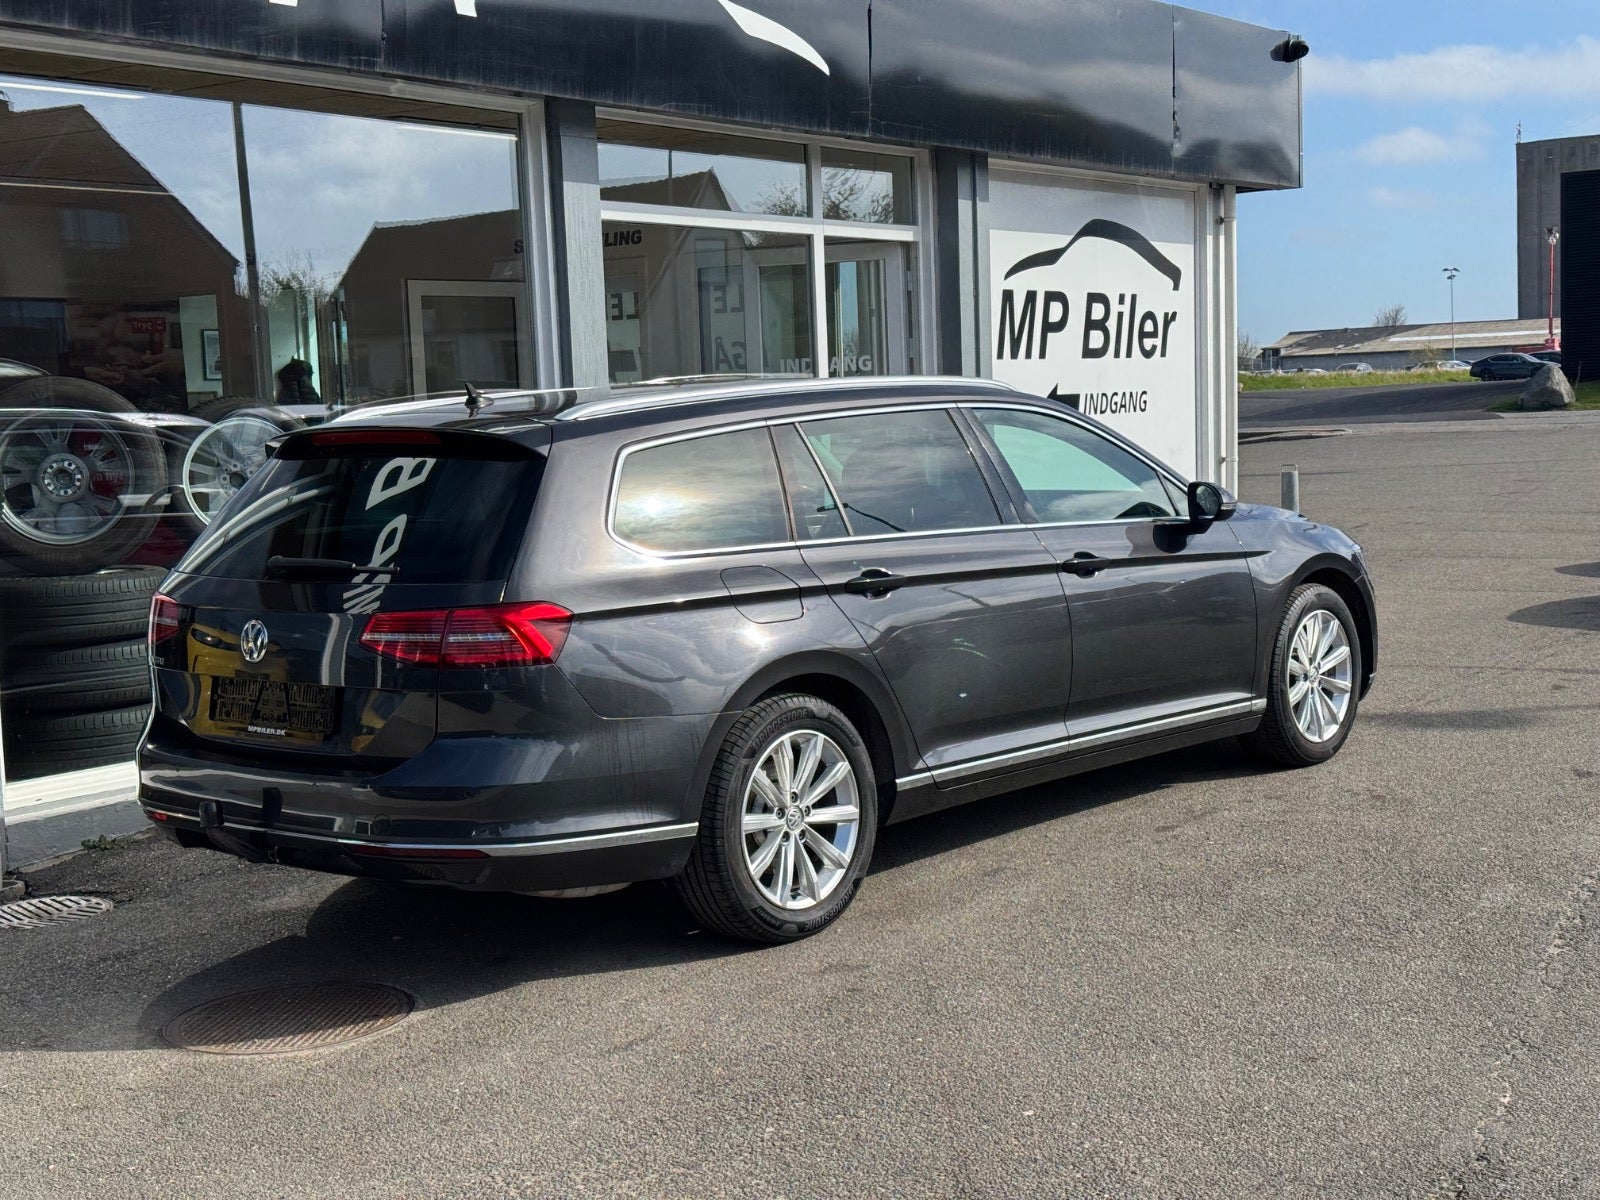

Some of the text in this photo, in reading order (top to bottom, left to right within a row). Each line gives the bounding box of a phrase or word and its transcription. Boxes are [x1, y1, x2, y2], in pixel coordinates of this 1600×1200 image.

[996, 288, 1178, 360] MP Biler
[779, 355, 872, 374] INDANG
[1083, 390, 1148, 415] INDGANG
[247, 725, 286, 736] MPBILER.DK
